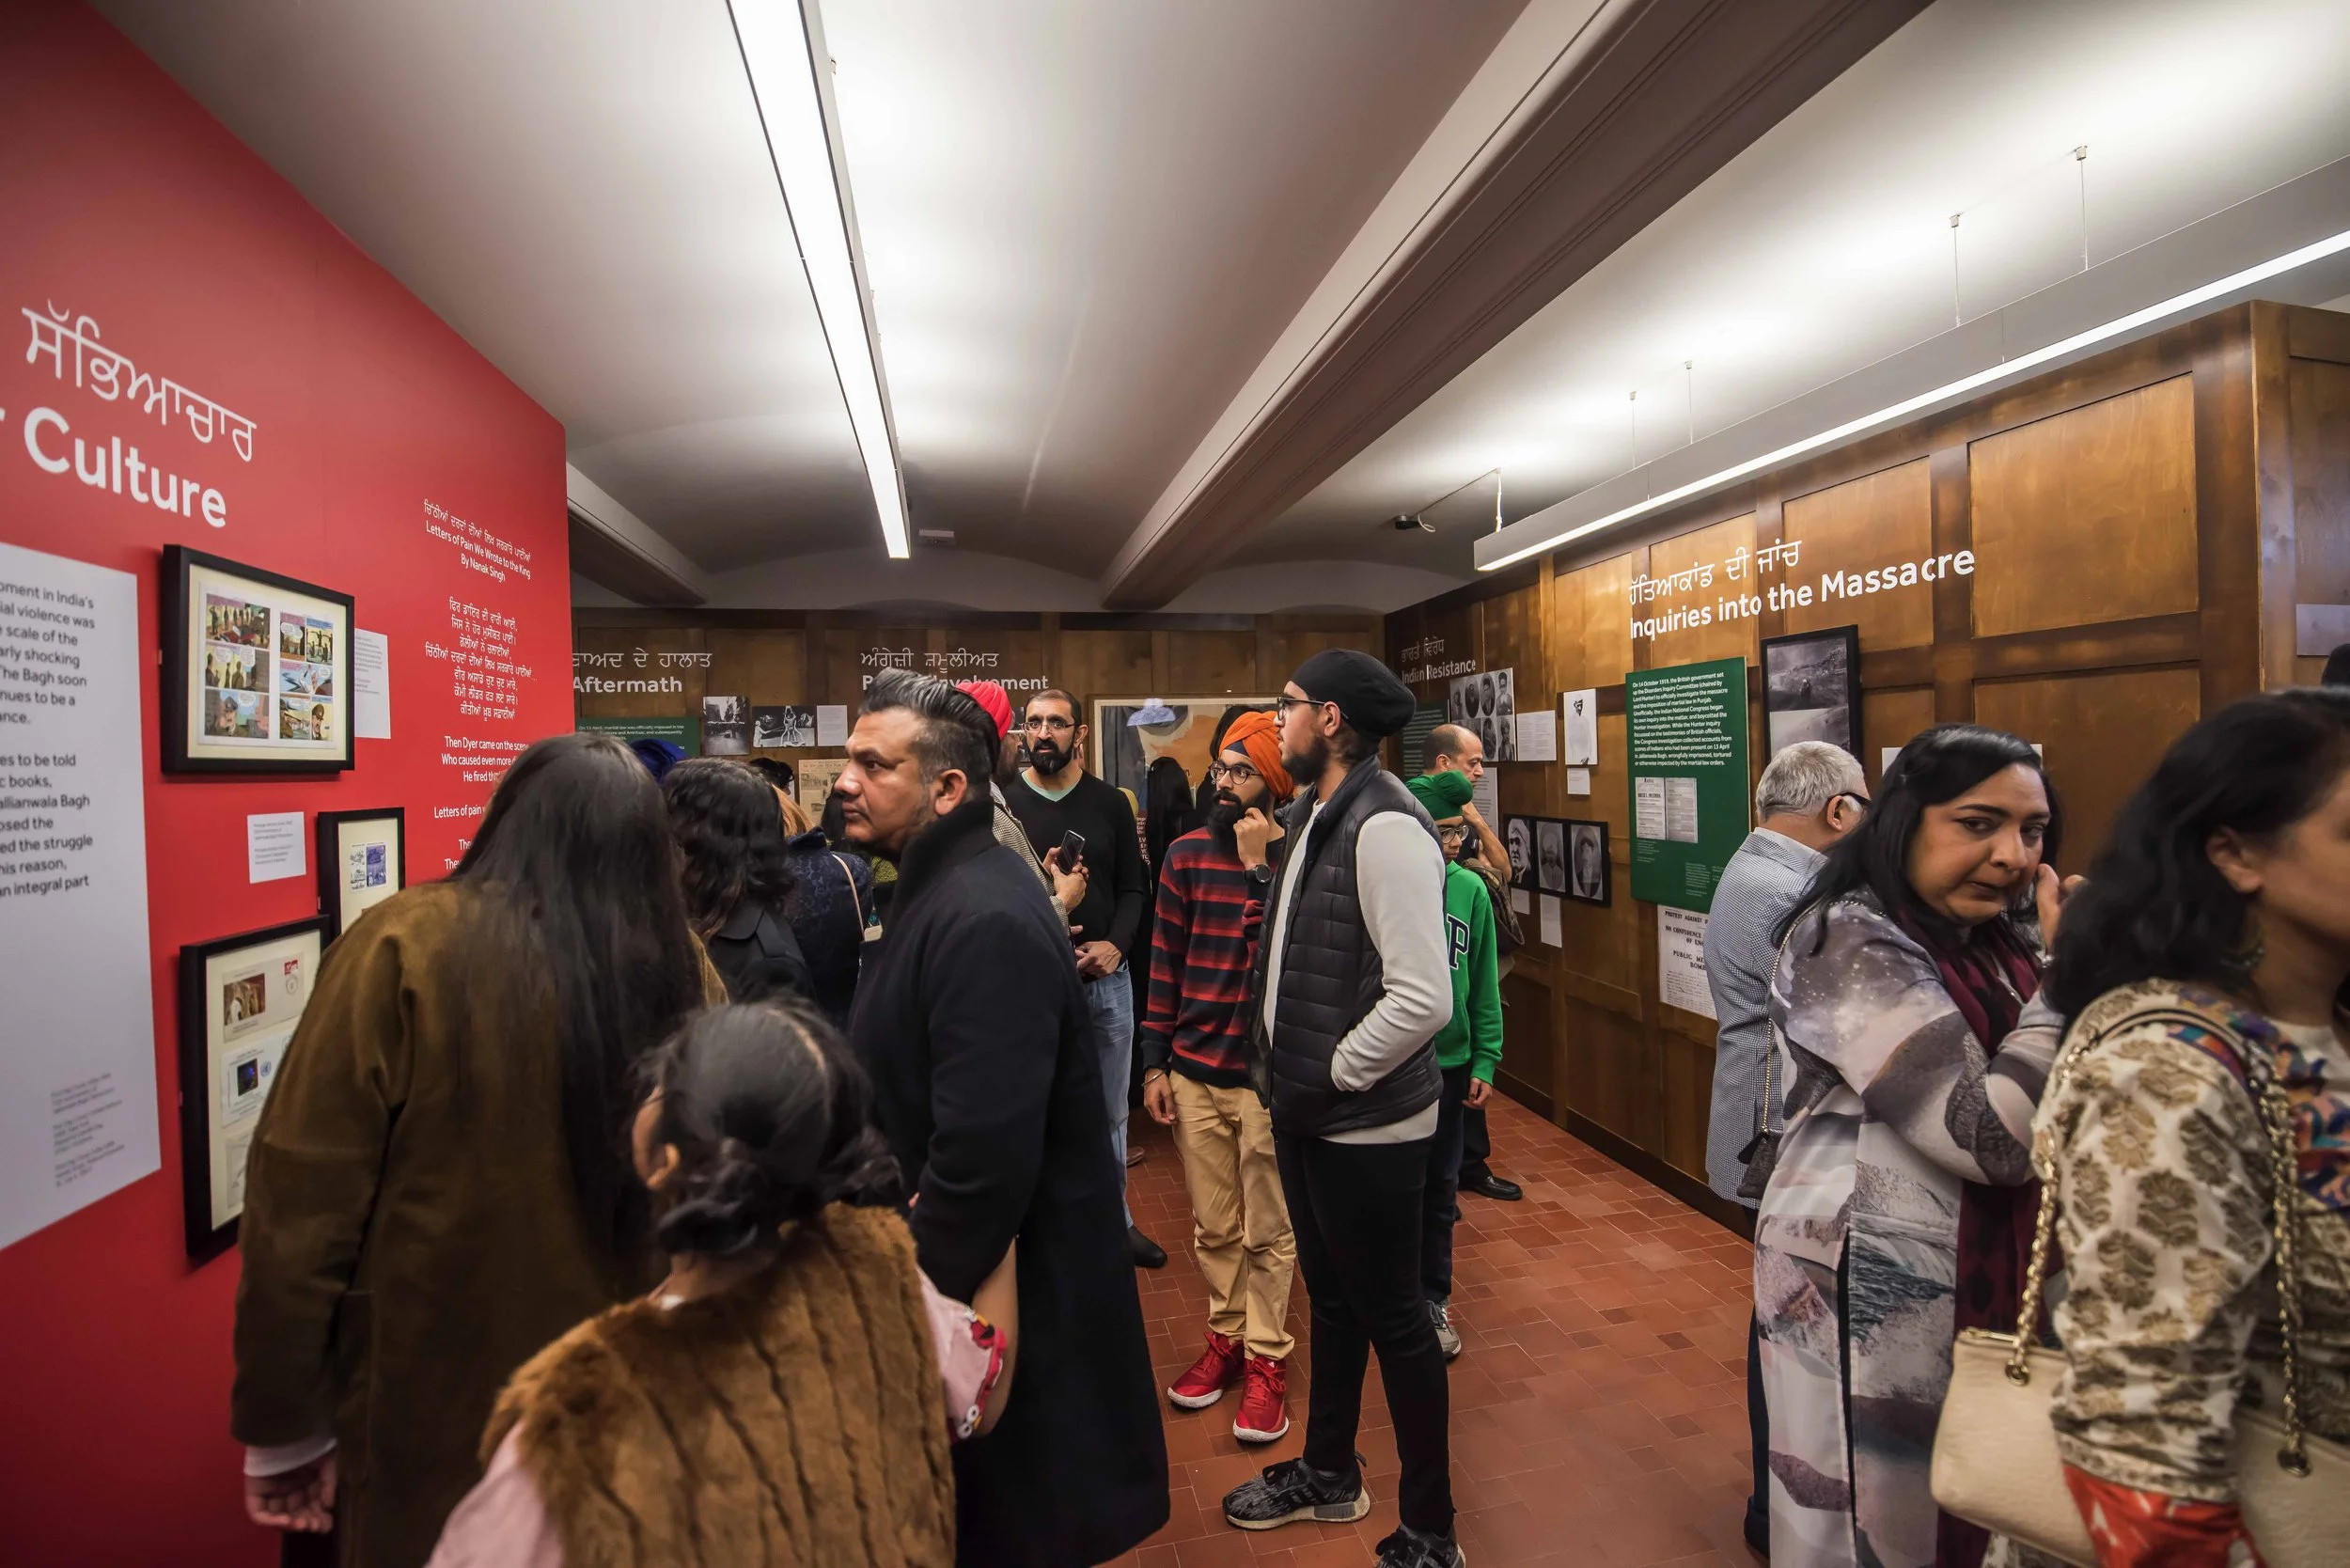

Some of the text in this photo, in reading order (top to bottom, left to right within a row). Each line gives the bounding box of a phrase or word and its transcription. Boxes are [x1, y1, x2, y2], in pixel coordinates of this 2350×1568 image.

[22, 298, 257, 462] ਸੱਭਿਆਚਾਰ
[24, 407, 227, 527] Culture
[426, 520, 531, 580] Letters of Pain We Wrote to the King
[1725, 546, 1750, 581] ਦੀ
[1756, 538, 1803, 574] ਜਾਂਚ
[461, 553, 506, 583] By Nanak Singh
[43, 588, 55, 602] in
[56, 590, 94, 609] India's
[1630, 550, 1975, 641] Inquiries into the Massacre
[18, 605, 70, 625] violence
[72, 617, 96, 629] was
[6, 626, 39, 640] scale
[42, 630, 55, 642] of
[58, 633, 78, 646] the
[24, 649, 80, 669] shocking
[633, 647, 650, 667] ਦੇ
[658, 652, 713, 668] ਹਾਲਾਤ
[23, 668, 55, 686] Bagh
[57, 675, 87, 686] soon
[1402, 659, 1477, 685] Indian Resistance
[1691, 673, 1716, 682] government
[573, 676, 682, 693] Aftermath
[35, 691, 48, 704] to
[51, 692, 66, 705] be
[69, 696, 75, 706] a
[445, 736, 462, 748] Then
[462, 737, 478, 751] Dyer
[478, 740, 495, 750] came
[496, 741, 504, 750] on
[504, 740, 513, 750] the
[18, 754, 32, 766] to
[34, 753, 50, 766] be
[53, 754, 76, 766] told
[442, 753, 457, 765] Who
[458, 755, 481, 766] caused
[481, 757, 496, 766] even
[496, 758, 511, 766] more
[463, 771, 472, 782] He
[474, 771, 488, 782] fired
[60, 794, 90, 809] Bagh
[434, 806, 460, 819] Letters
[461, 805, 468, 816] of
[469, 805, 482, 818] pain
[33, 817, 54, 829] the
[19, 839, 40, 853] the
[43, 834, 93, 851] struggle
[19, 859, 68, 873] reason,
[14, 877, 62, 896] integral
[65, 874, 89, 892] part
[1447, 914, 1469, 970] P
[1673, 949, 1692, 960] PUBLIC
